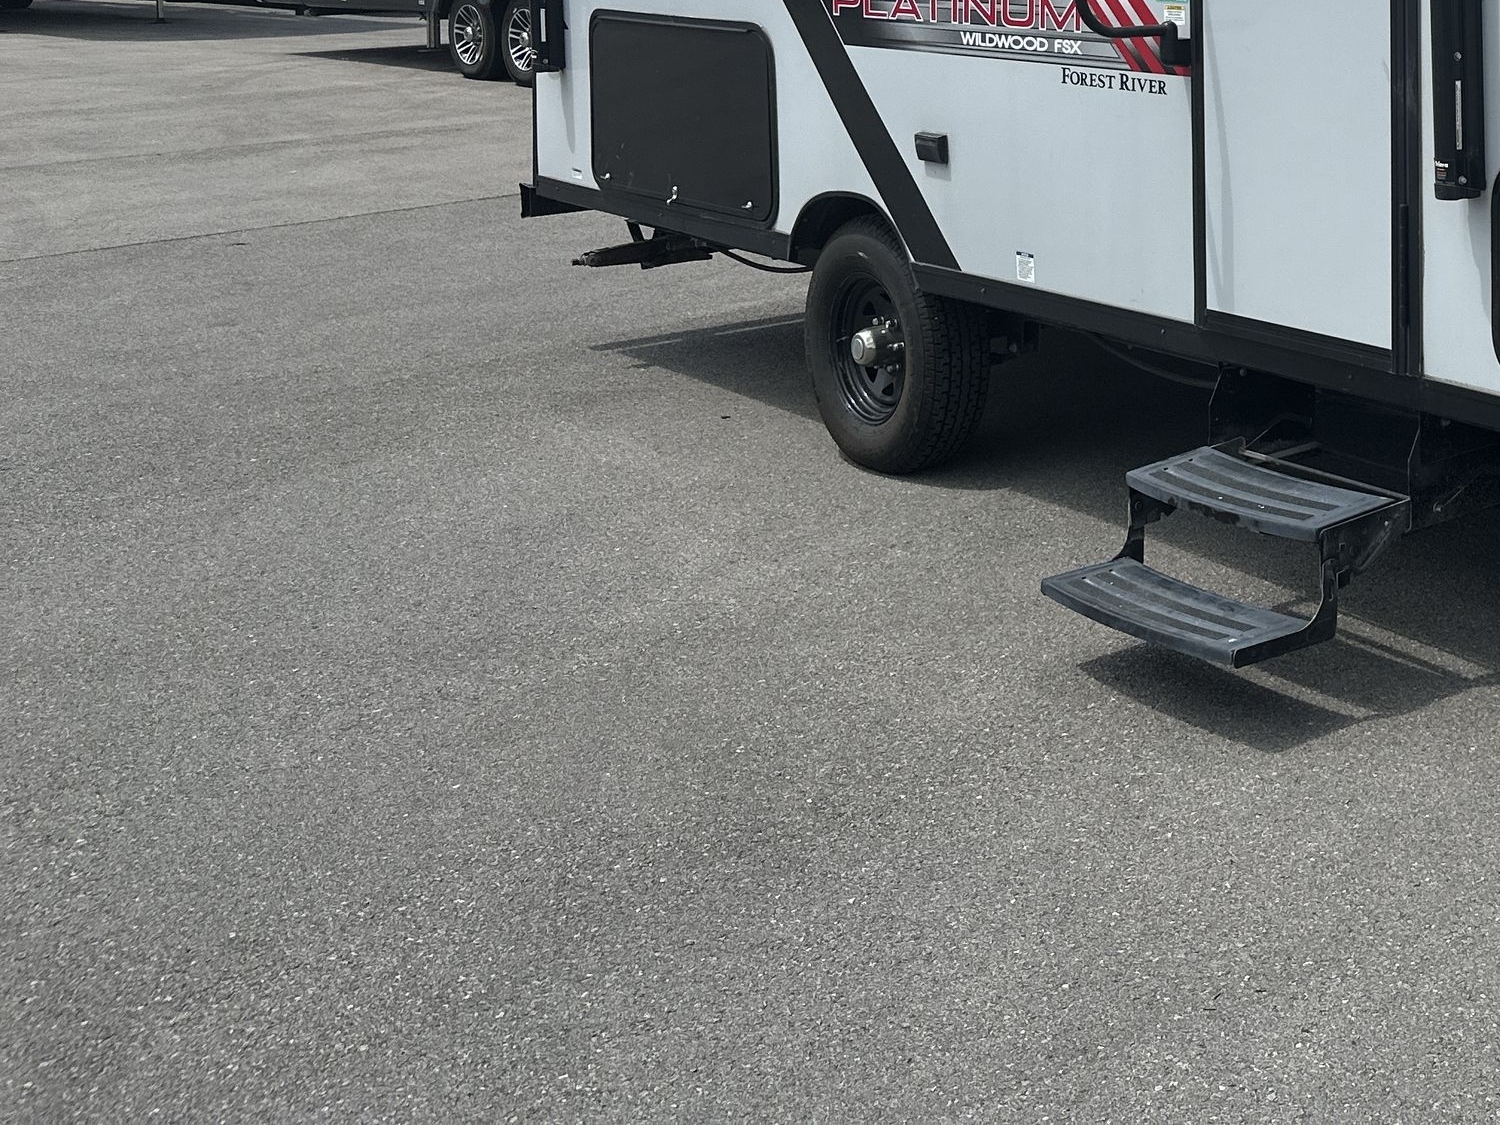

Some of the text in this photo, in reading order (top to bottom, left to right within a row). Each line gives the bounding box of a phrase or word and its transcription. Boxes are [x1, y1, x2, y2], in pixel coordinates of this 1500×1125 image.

[960, 31, 1082, 55] WILDWOOD FSX
[1061, 66, 1168, 95] FOREST RIVER
